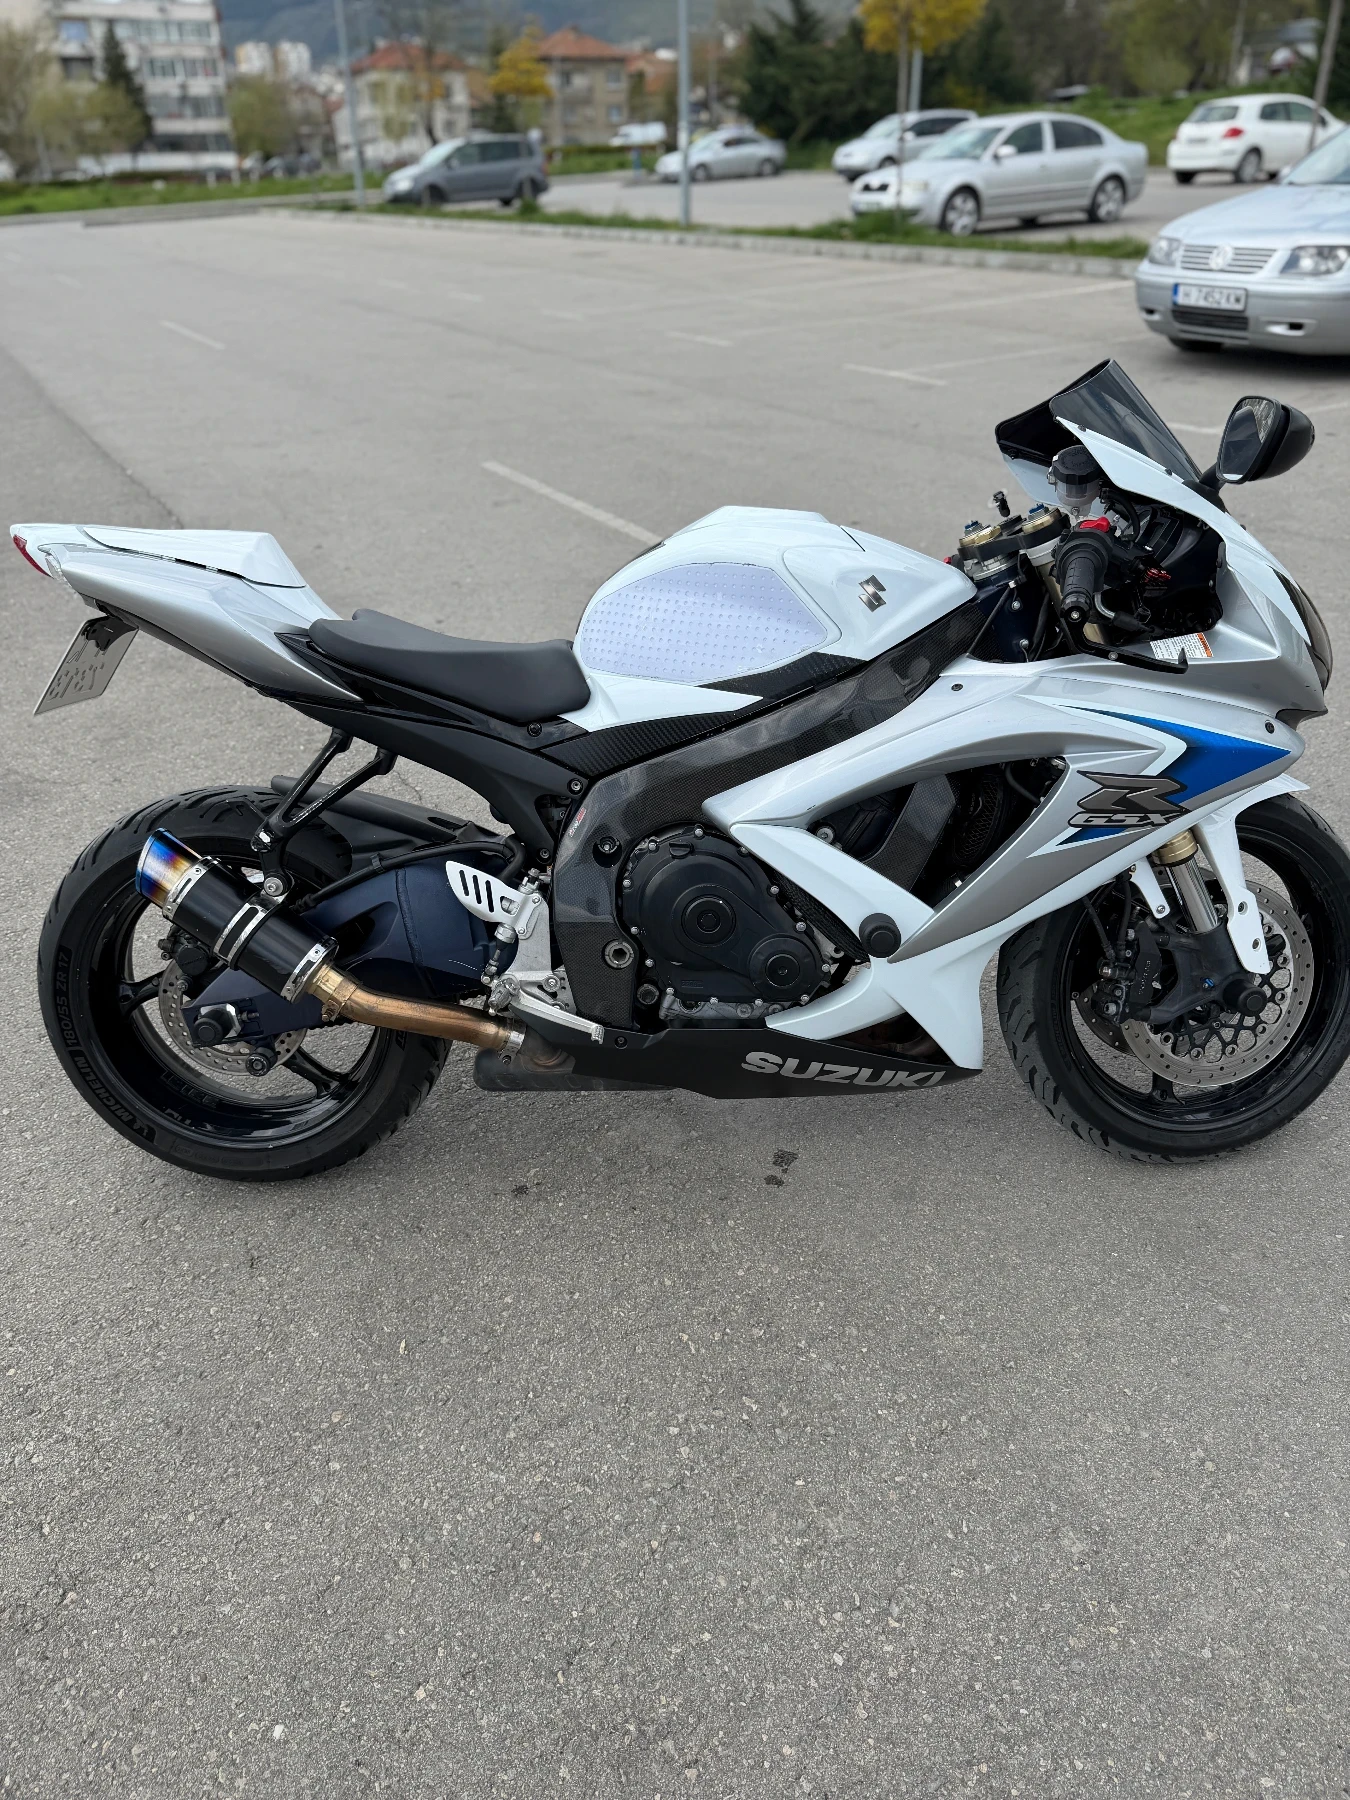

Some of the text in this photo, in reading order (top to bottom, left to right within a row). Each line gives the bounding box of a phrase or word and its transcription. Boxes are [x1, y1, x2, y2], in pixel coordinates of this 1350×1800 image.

[56, 952, 134, 1122] MICHELIN 180/55 ZR 17
[741, 1051, 946, 1087] SUZUKI
